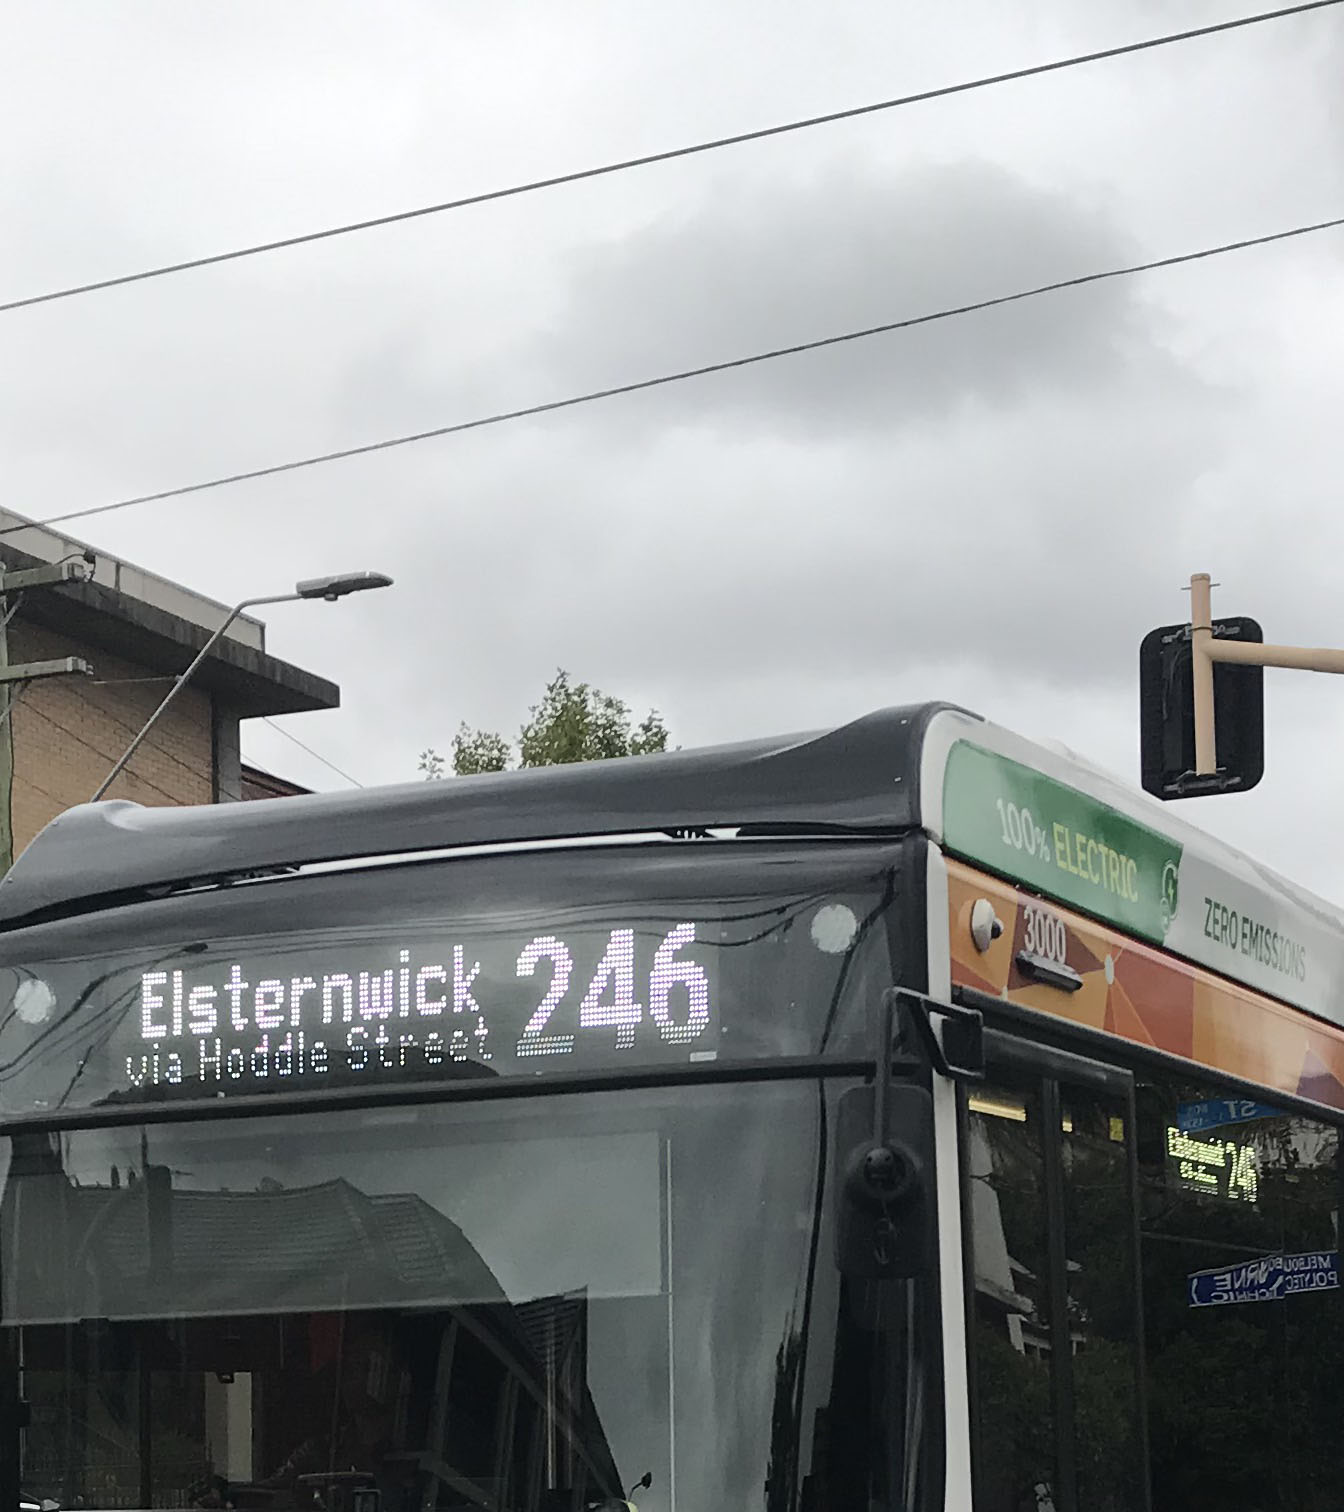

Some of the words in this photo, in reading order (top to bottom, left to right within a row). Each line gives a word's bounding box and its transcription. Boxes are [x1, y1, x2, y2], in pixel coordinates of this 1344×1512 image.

[996, 797, 1051, 862] 100%
[1052, 821, 1138, 902] ELECTRIC
[1023, 905, 1066, 965] 3000
[1204, 896, 1238, 950] ZERO
[1241, 916, 1306, 982] EMISSIONS
[141, 944, 481, 1040] Elsternwick
[515, 922, 711, 1057] 246
[126, 1043, 183, 1086] via
[198, 1030, 329, 1081] Hoddle
[346, 1016, 494, 1069] Street
